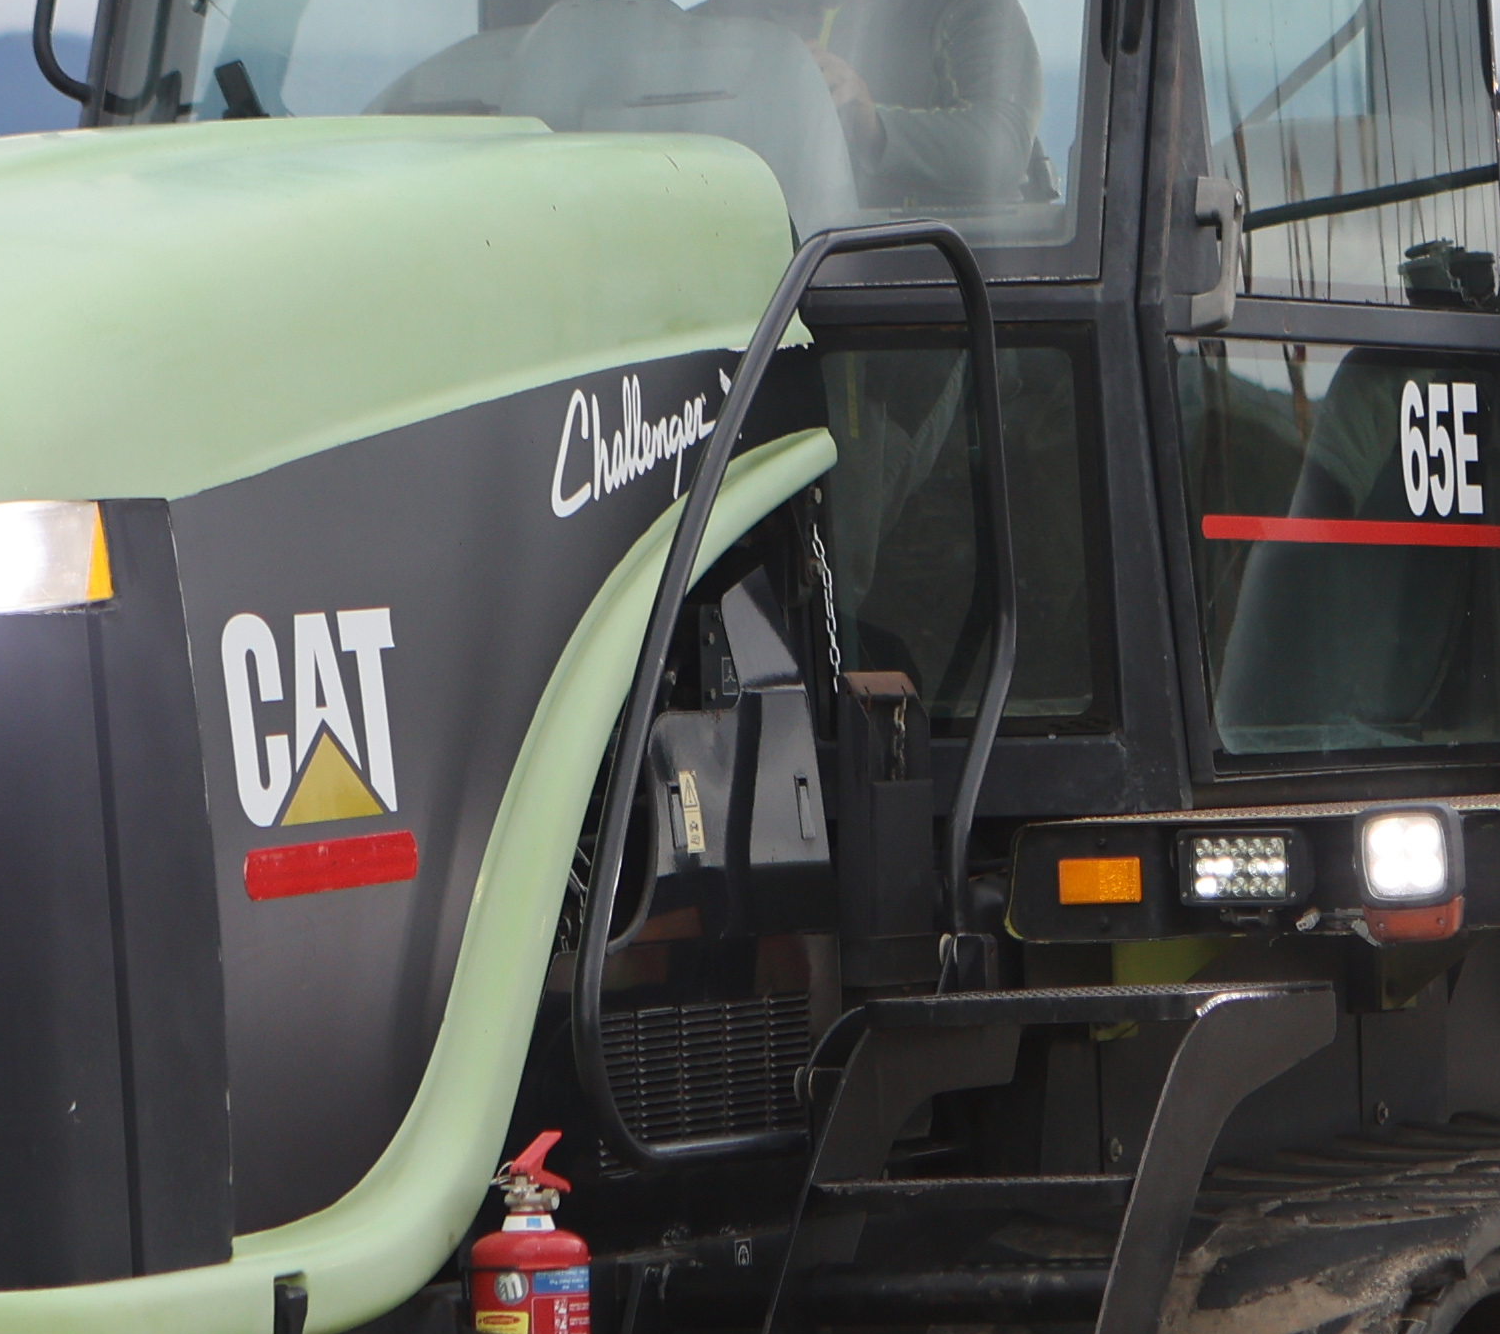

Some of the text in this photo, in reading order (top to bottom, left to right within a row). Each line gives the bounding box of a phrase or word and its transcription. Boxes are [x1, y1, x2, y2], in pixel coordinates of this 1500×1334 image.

[551, 373, 717, 518] Challenger
[1399, 380, 1484, 517] 65E
[220, 607, 398, 827] CAT
